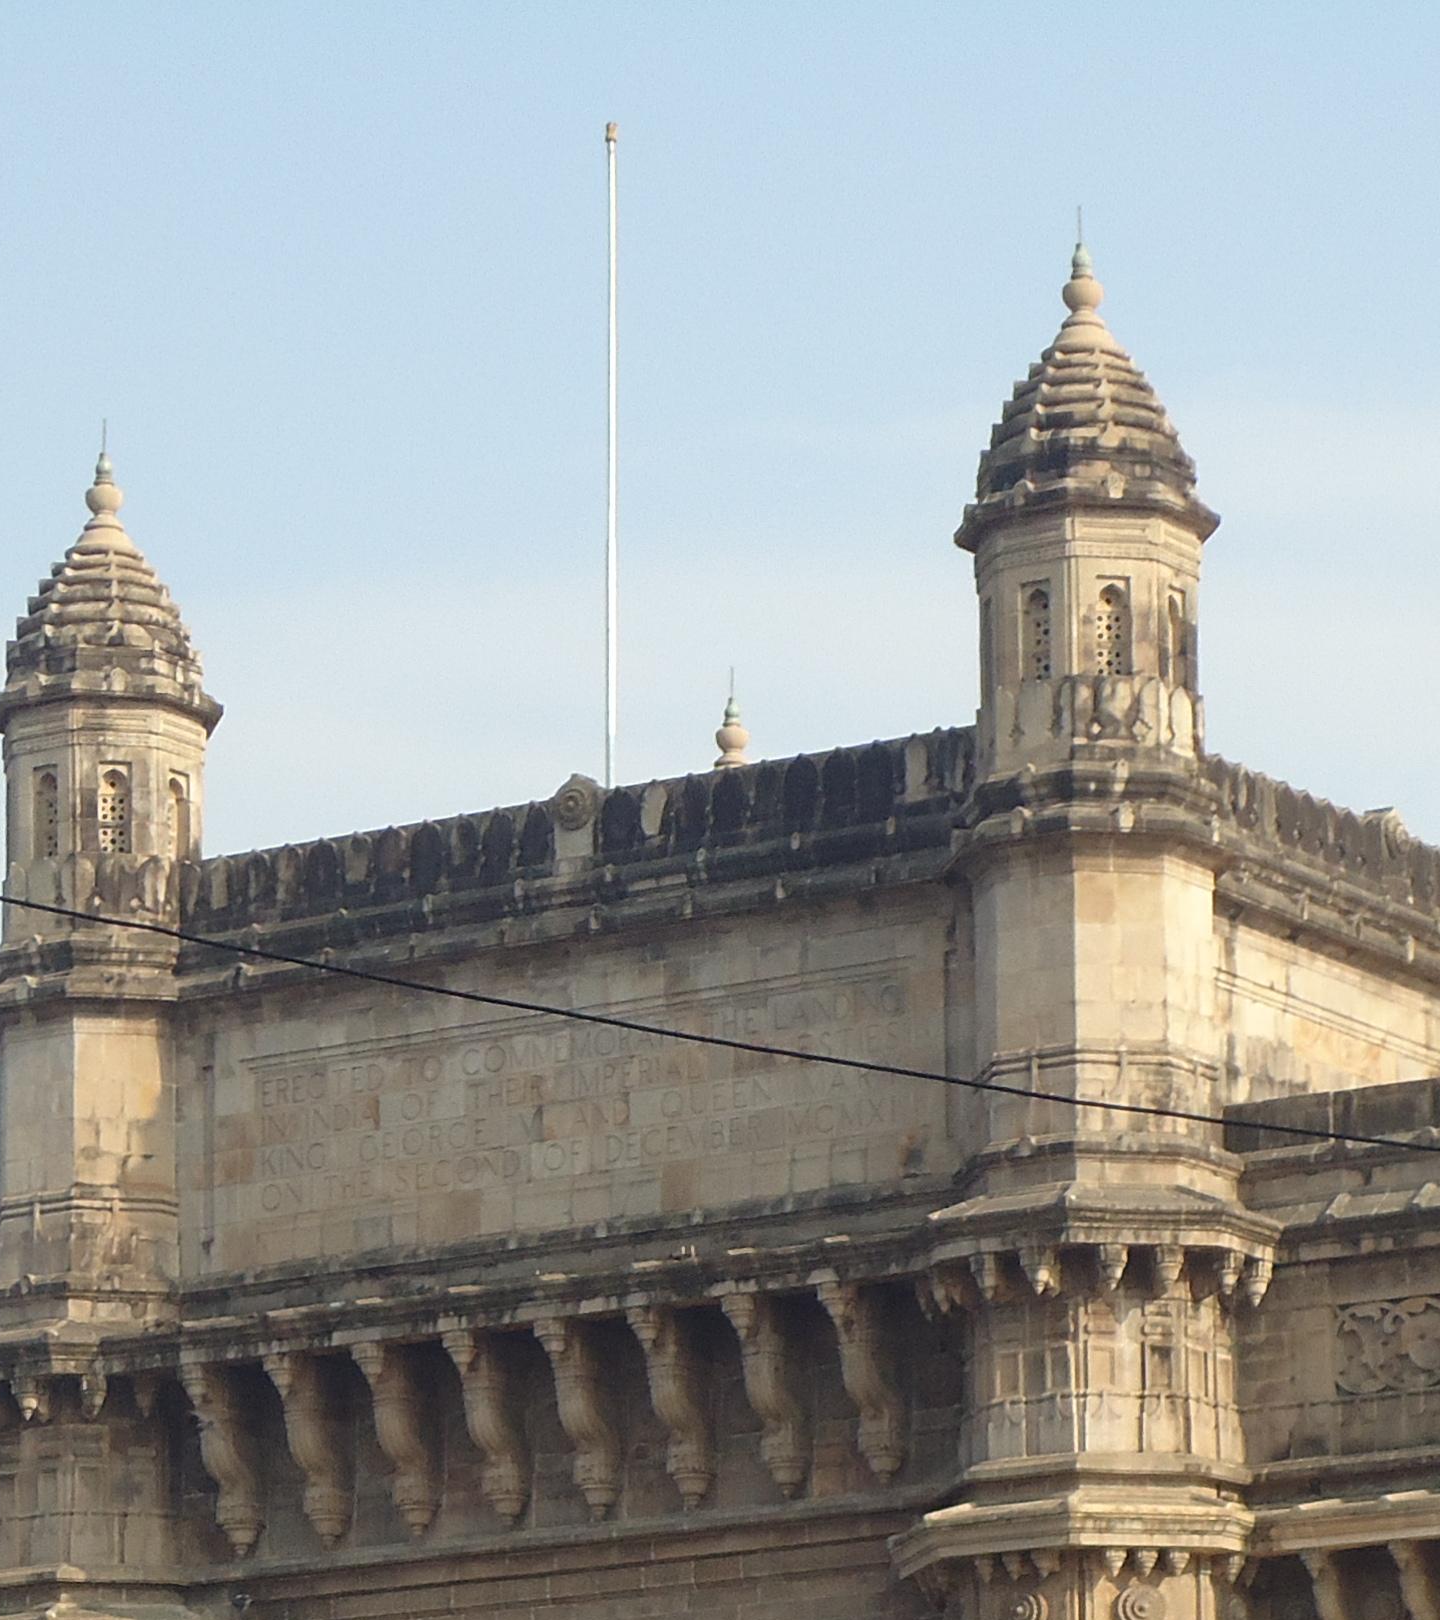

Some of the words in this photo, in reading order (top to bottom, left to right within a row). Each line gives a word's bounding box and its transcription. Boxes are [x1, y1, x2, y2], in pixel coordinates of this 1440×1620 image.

[261, 1062, 385, 1107] ERECTED
[403, 1054, 443, 1086] TO
[401, 1092, 439, 1121] OF
[467, 1073, 544, 1110] THEIR
[261, 1141, 326, 1177] KING
[359, 1119, 486, 1163] GEORGE
[573, 1091, 631, 1132] AND
[660, 1073, 773, 1118] QUEEN
[261, 1180, 303, 1212] ON
[323, 1170, 375, 1202] THE
[394, 1149, 521, 1193] SECOND
[543, 1139, 583, 1172] OF
[606, 1114, 763, 1164] DECEMBER
